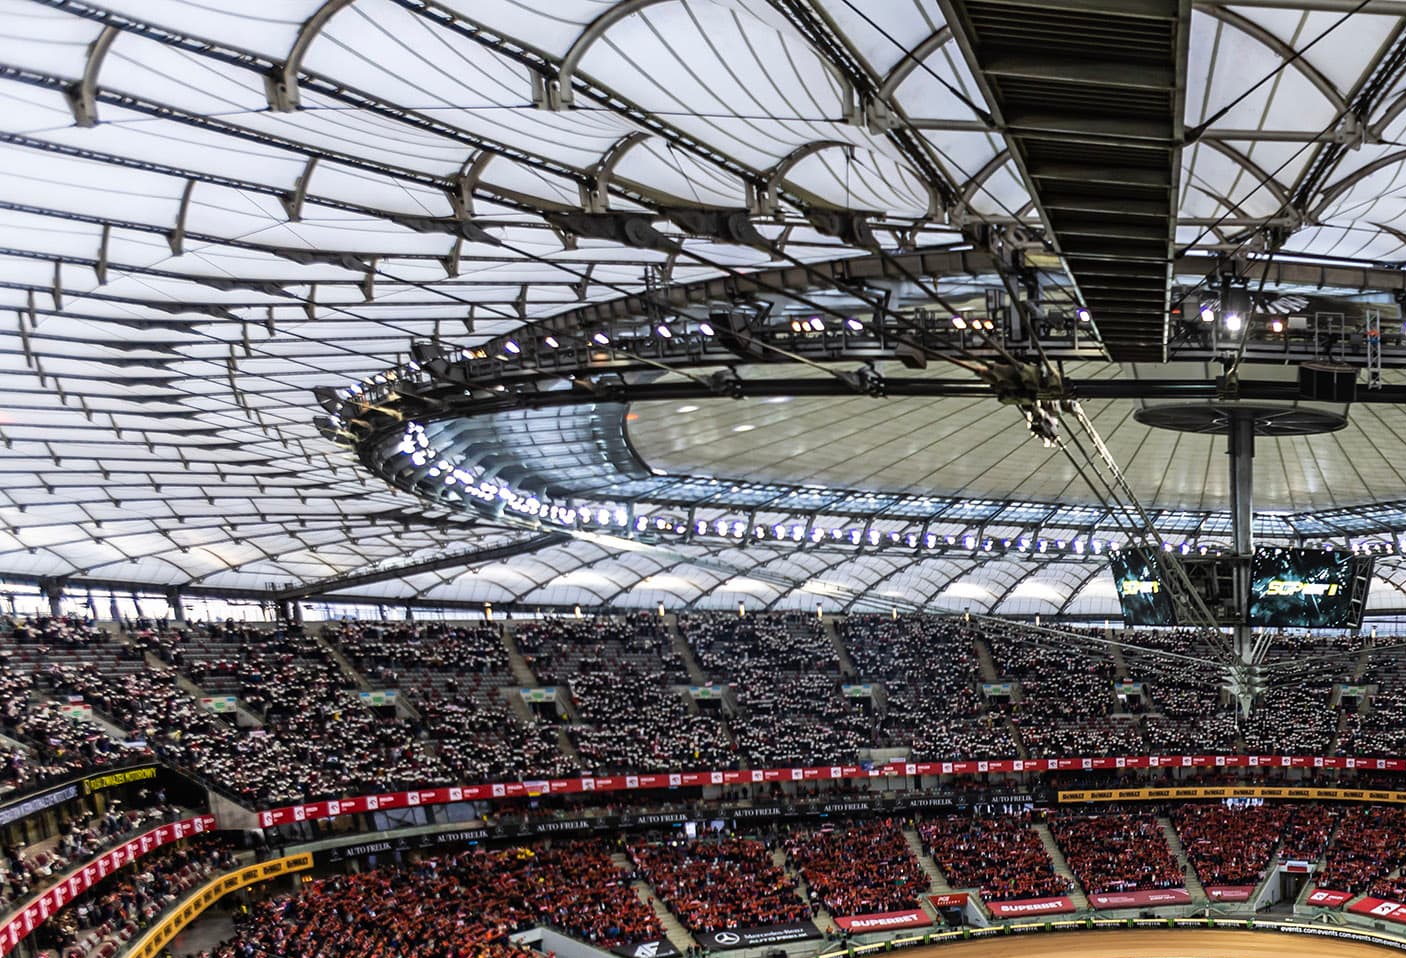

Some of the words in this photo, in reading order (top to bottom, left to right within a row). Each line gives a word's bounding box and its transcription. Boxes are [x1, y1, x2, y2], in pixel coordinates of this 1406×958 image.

[910, 800, 928, 808] AUTO
[929, 799, 953, 807] FRELIK
[1011, 795, 1032, 803] FRELIK
[734, 809, 754, 817] AUTO
[755, 808, 781, 816] FRELIK
[824, 804, 843, 813] AUTO
[844, 802, 868, 811] FRELIK
[638, 816, 659, 824] AUTO
[660, 813, 688, 823] FRELIK
[537, 823, 559, 833] AUTO
[560, 820, 589, 831] FRELIK
[438, 834, 459, 843] AUTO
[460, 830, 488, 841] FRELIK
[346, 846, 365, 856] AUTO
[366, 842, 391, 853] FRELIK
[1001, 901, 1063, 912] SUPERBET
[852, 914, 919, 927] SUPERBET
